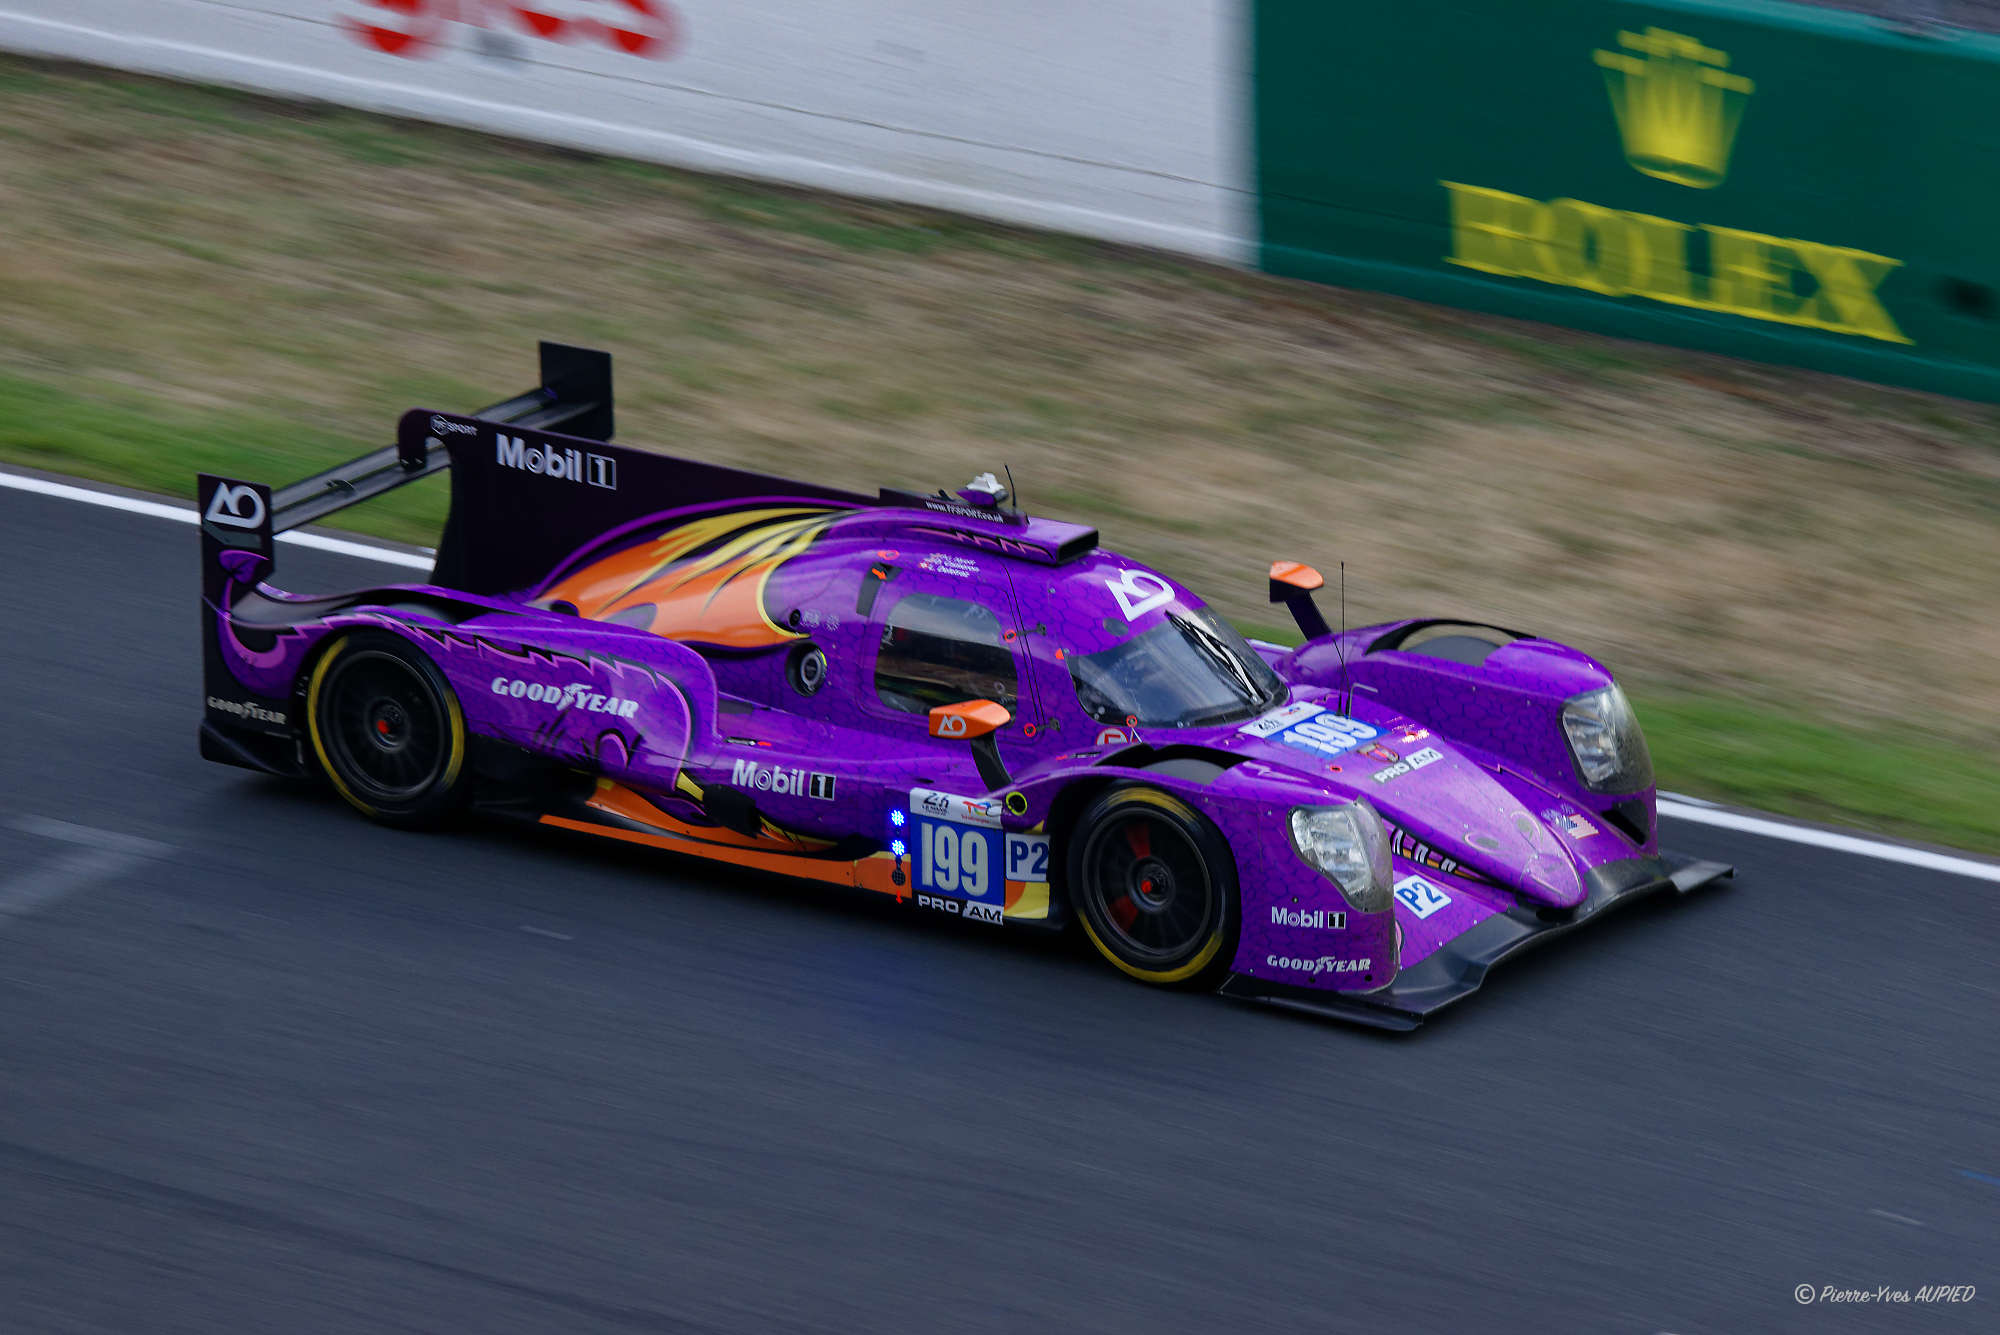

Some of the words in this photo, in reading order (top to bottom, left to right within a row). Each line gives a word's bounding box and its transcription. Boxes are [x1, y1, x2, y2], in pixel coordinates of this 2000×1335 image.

[1437, 179, 1916, 346] ROLEX
[496, 433, 583, 483] Mobil
[207, 696, 287, 724] GOODYEAR
[491, 677, 639, 718] GOODYEAR
[1283, 713, 1378, 754] 199
[731, 758, 805, 797] Mobil
[1374, 762, 1410, 783] PRO
[1413, 750, 1440, 765] AM
[921, 822, 989, 897] 199
[1010, 839, 1050, 875] P2
[918, 894, 959, 913] PRO
[969, 904, 1003, 923] AM
[1396, 881, 1443, 913] P2
[1271, 906, 1324, 929] Mobil
[1266, 955, 1371, 974] GOODYEAR
